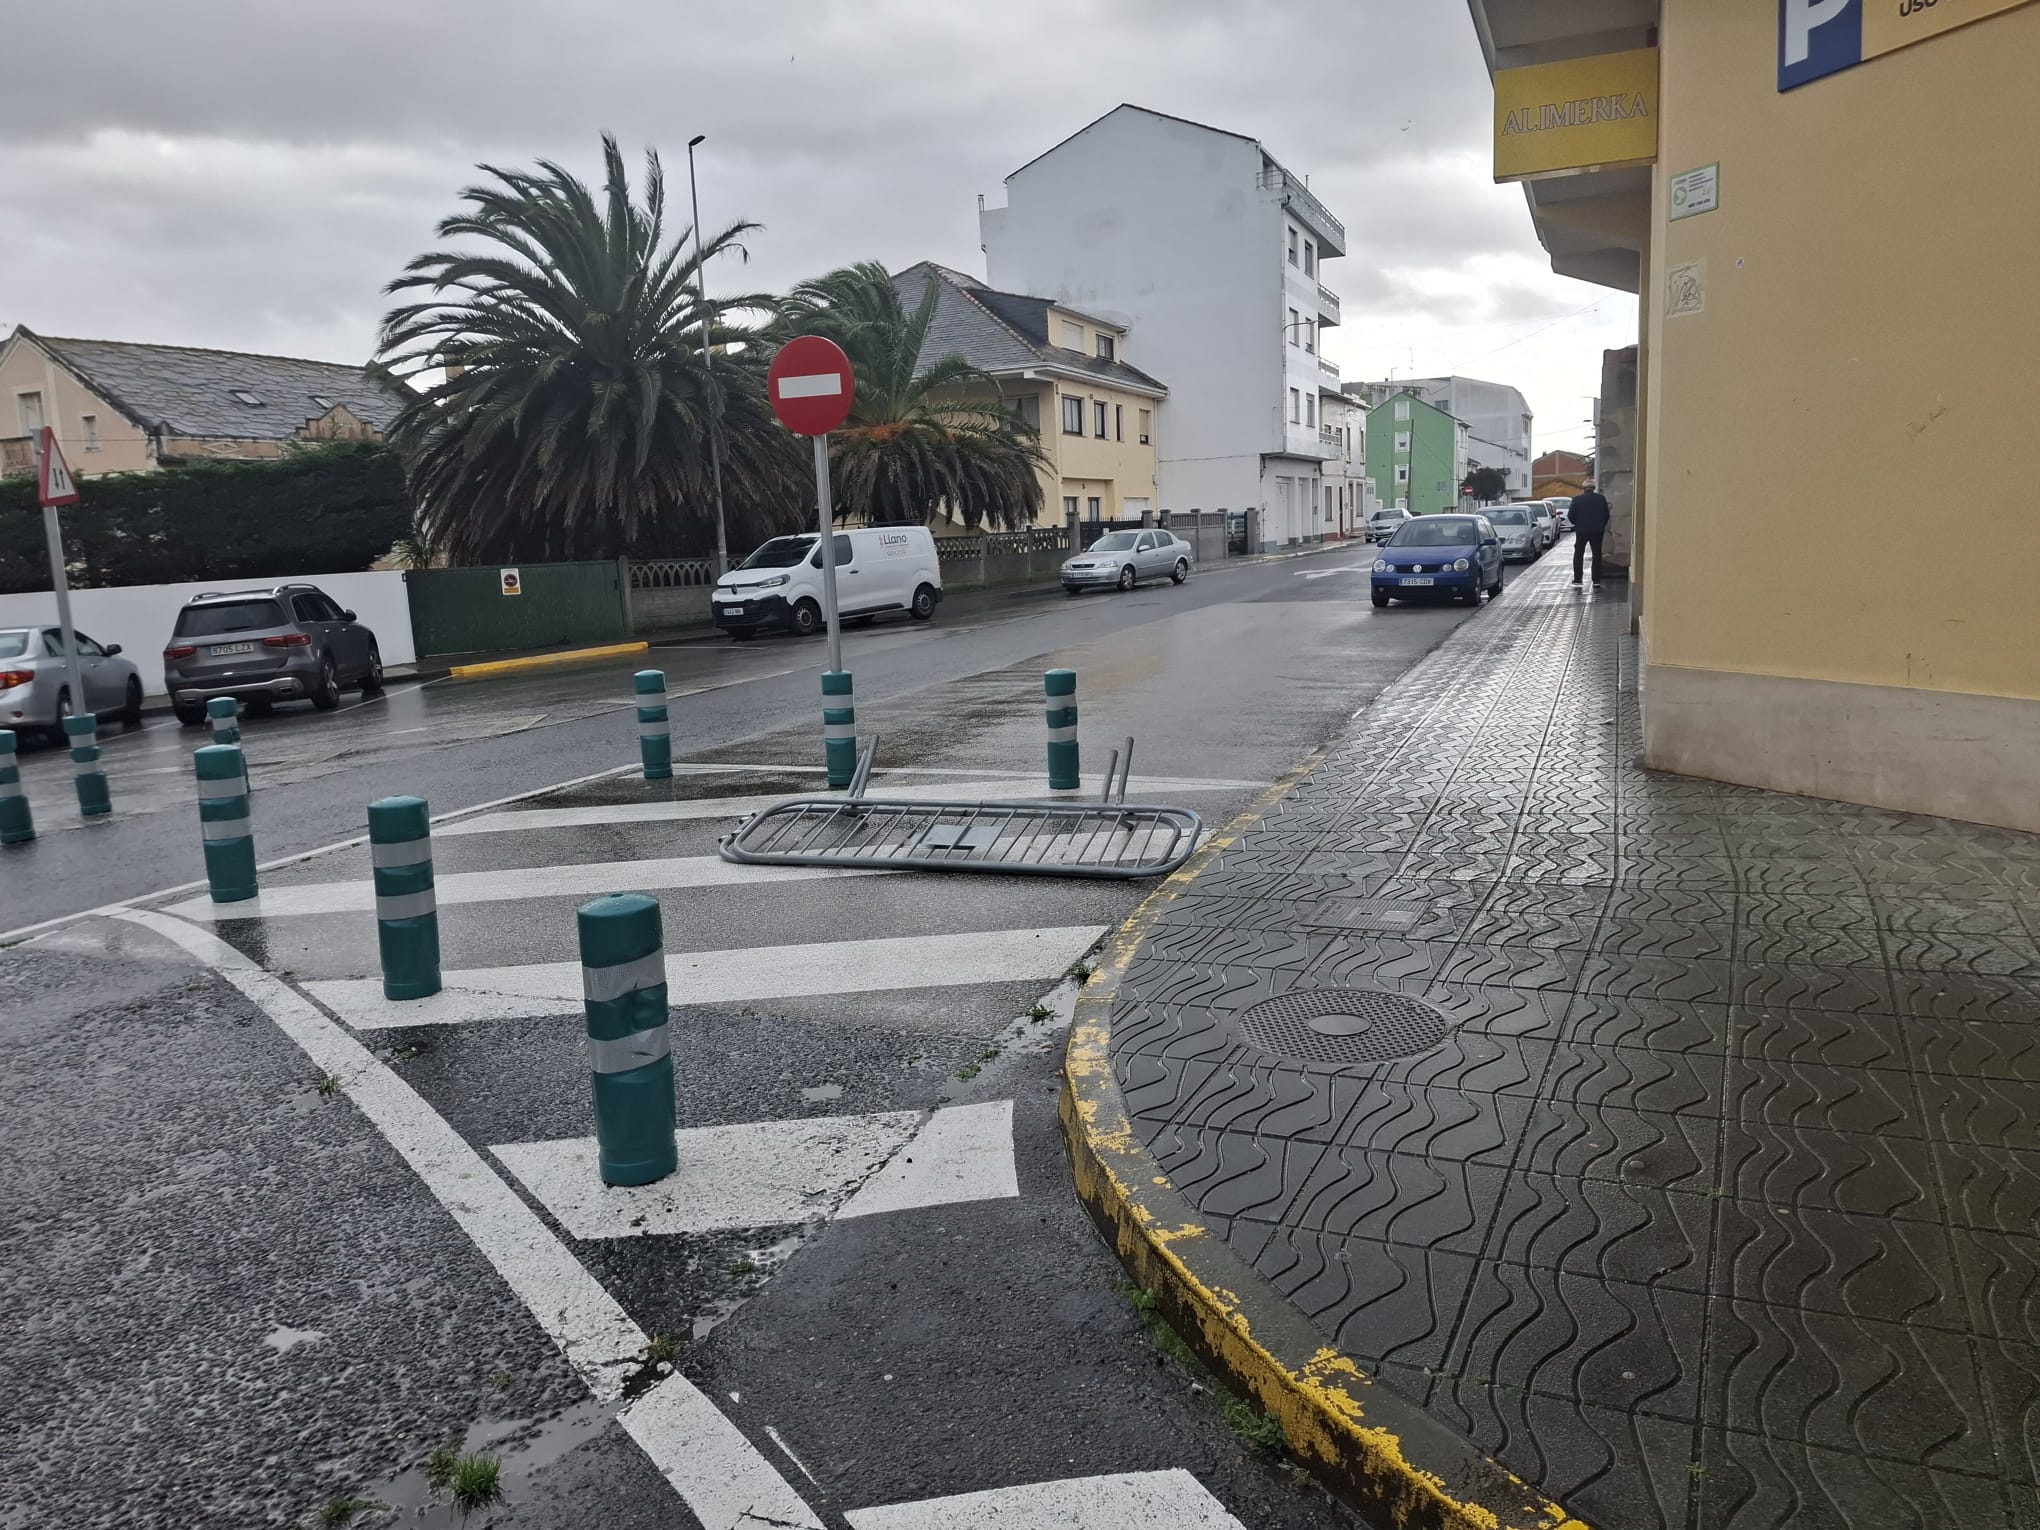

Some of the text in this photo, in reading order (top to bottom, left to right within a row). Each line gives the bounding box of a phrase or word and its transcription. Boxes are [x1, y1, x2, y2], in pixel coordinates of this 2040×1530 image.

[1785, 0, 1850, 66] P
[1501, 91, 1648, 136] ALIMERKA
[883, 533, 907, 545] Llano
